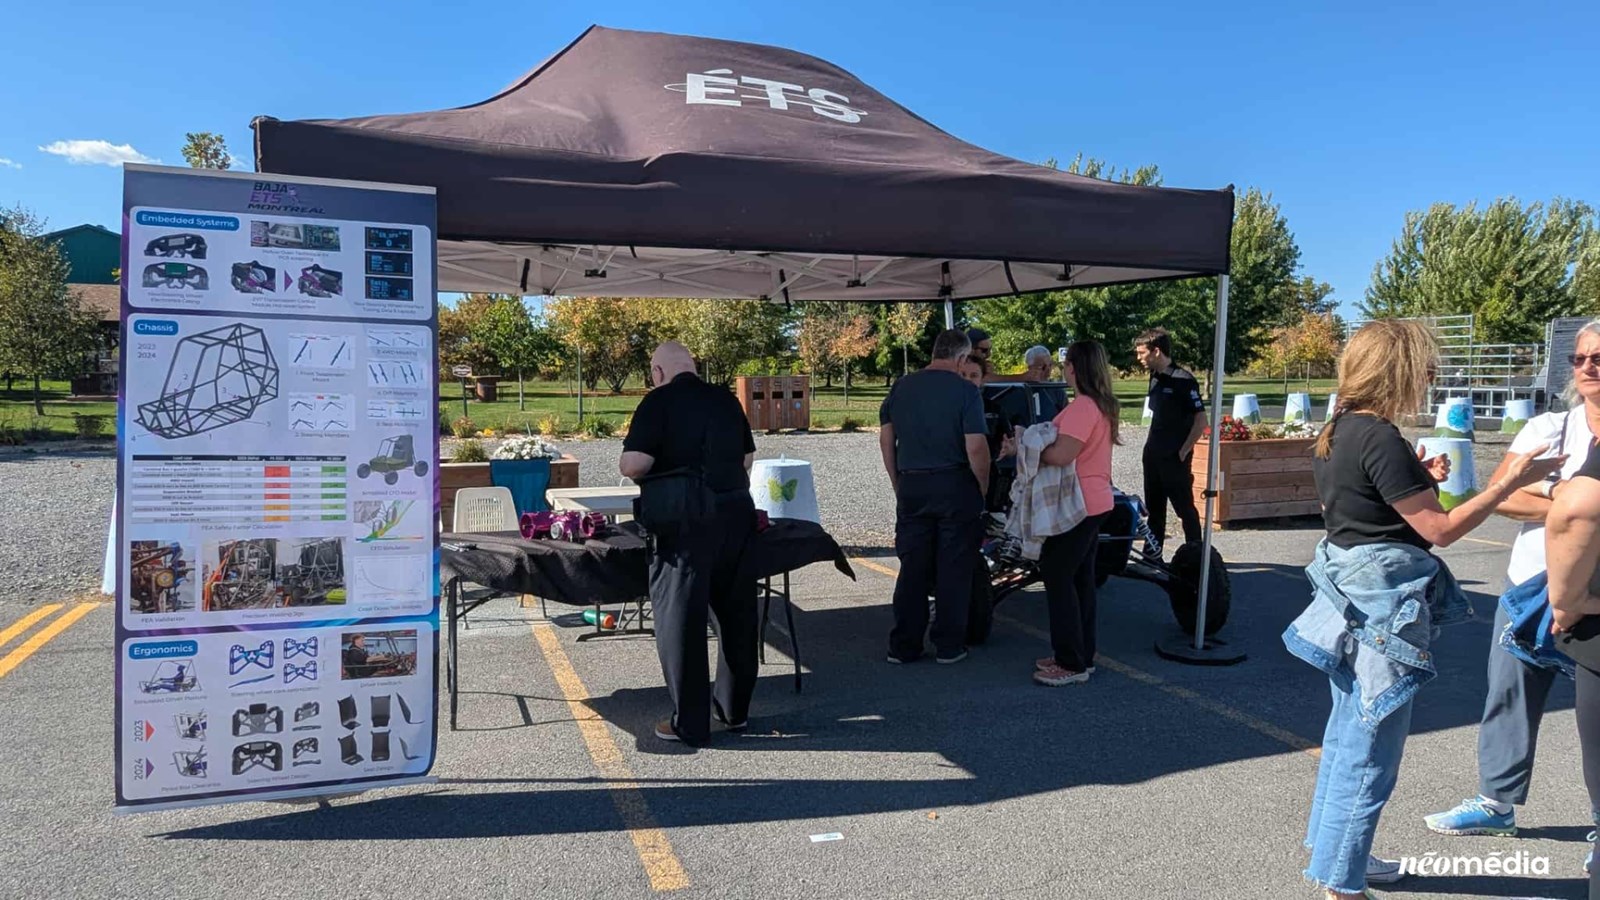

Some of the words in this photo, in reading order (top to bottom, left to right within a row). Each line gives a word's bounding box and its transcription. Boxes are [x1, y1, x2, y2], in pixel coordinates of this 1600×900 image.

[686, 68, 861, 123] ÉTS
[253, 182, 288, 194] BAJA
[250, 191, 281, 204] ETS
[248, 203, 326, 215] MONTREAL
[141, 214, 195, 225] Embedded
[195, 218, 235, 228] Systems
[137, 323, 174, 333] Chassis
[137, 351, 157, 359] 2024
[133, 644, 194, 657] Ergonomics
[134, 720, 144, 742] 2023
[134, 758, 144, 780] 2024
